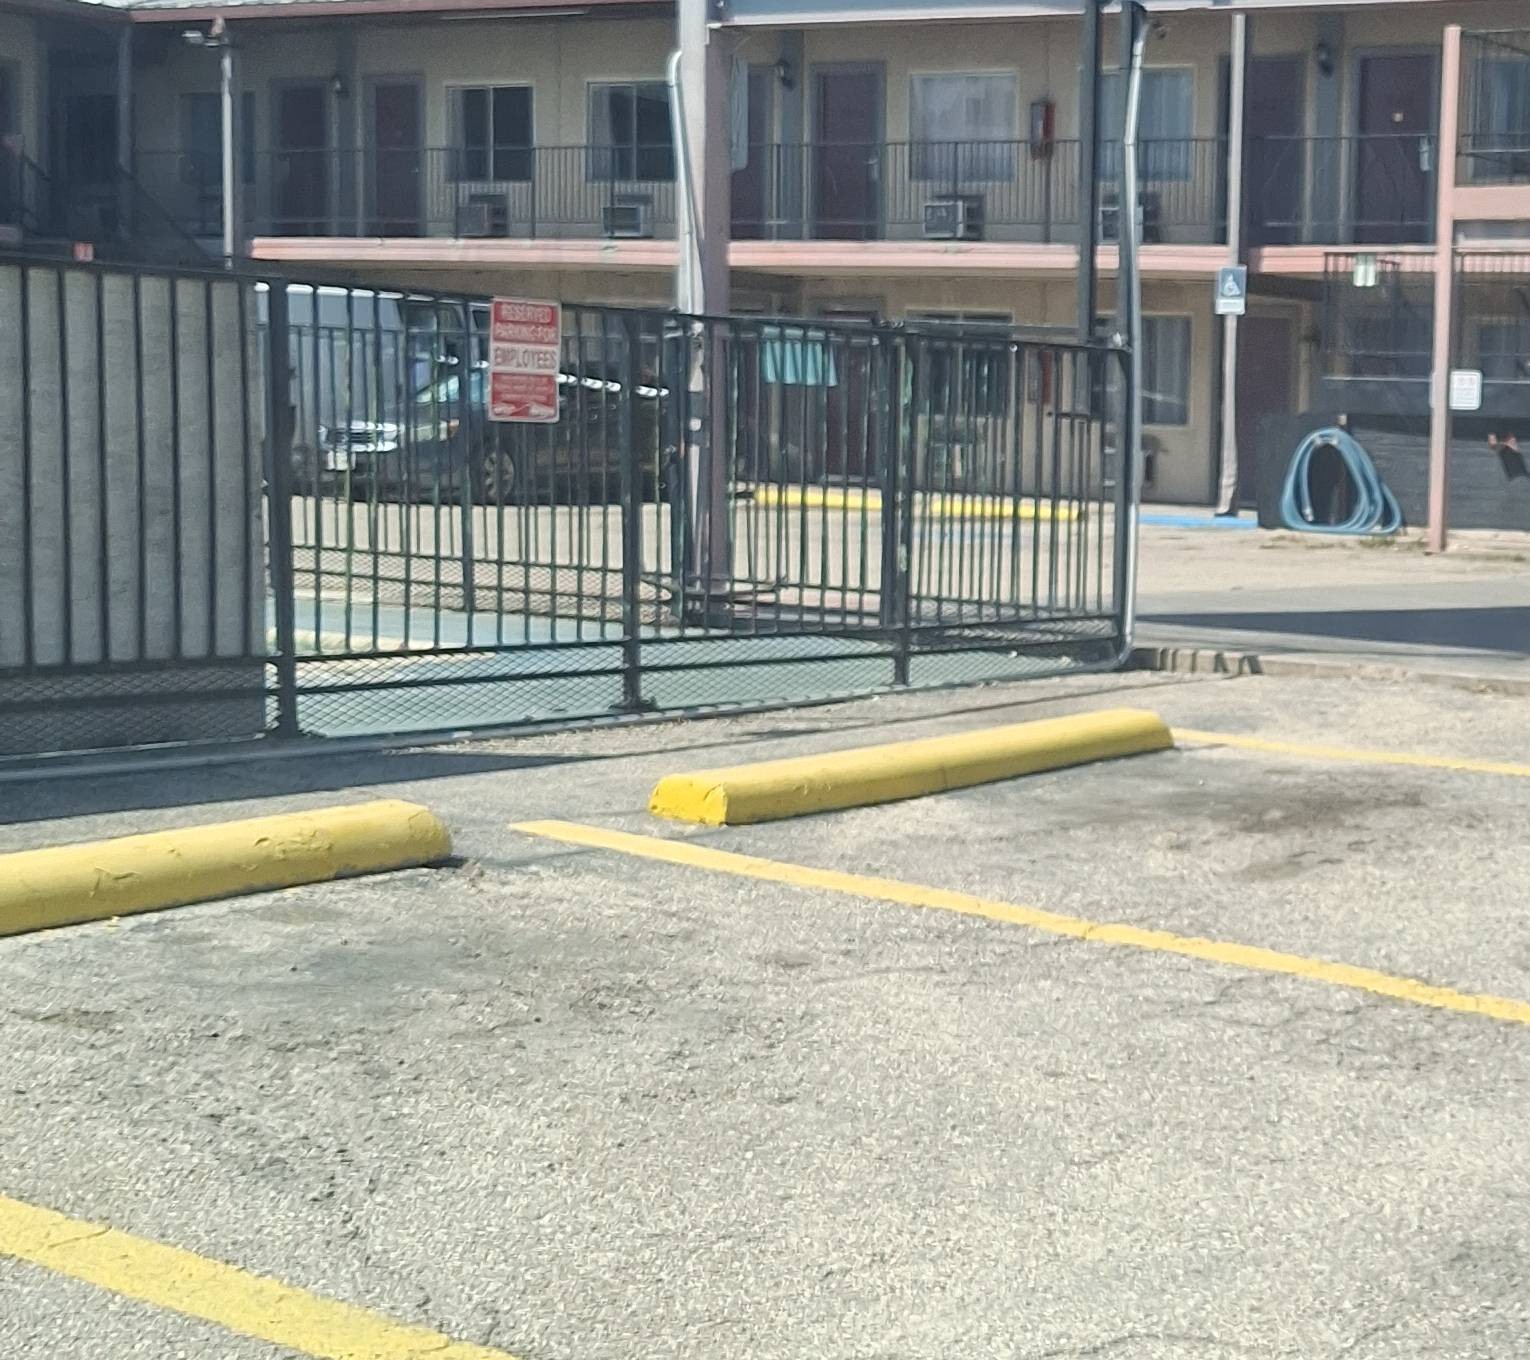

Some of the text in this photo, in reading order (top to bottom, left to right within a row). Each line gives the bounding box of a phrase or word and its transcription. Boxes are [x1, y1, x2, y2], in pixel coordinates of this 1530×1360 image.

[501, 303, 552, 323] RESERVED
[494, 322, 559, 343] PARKING FOR
[493, 346, 558, 370] EMPLOYEES
